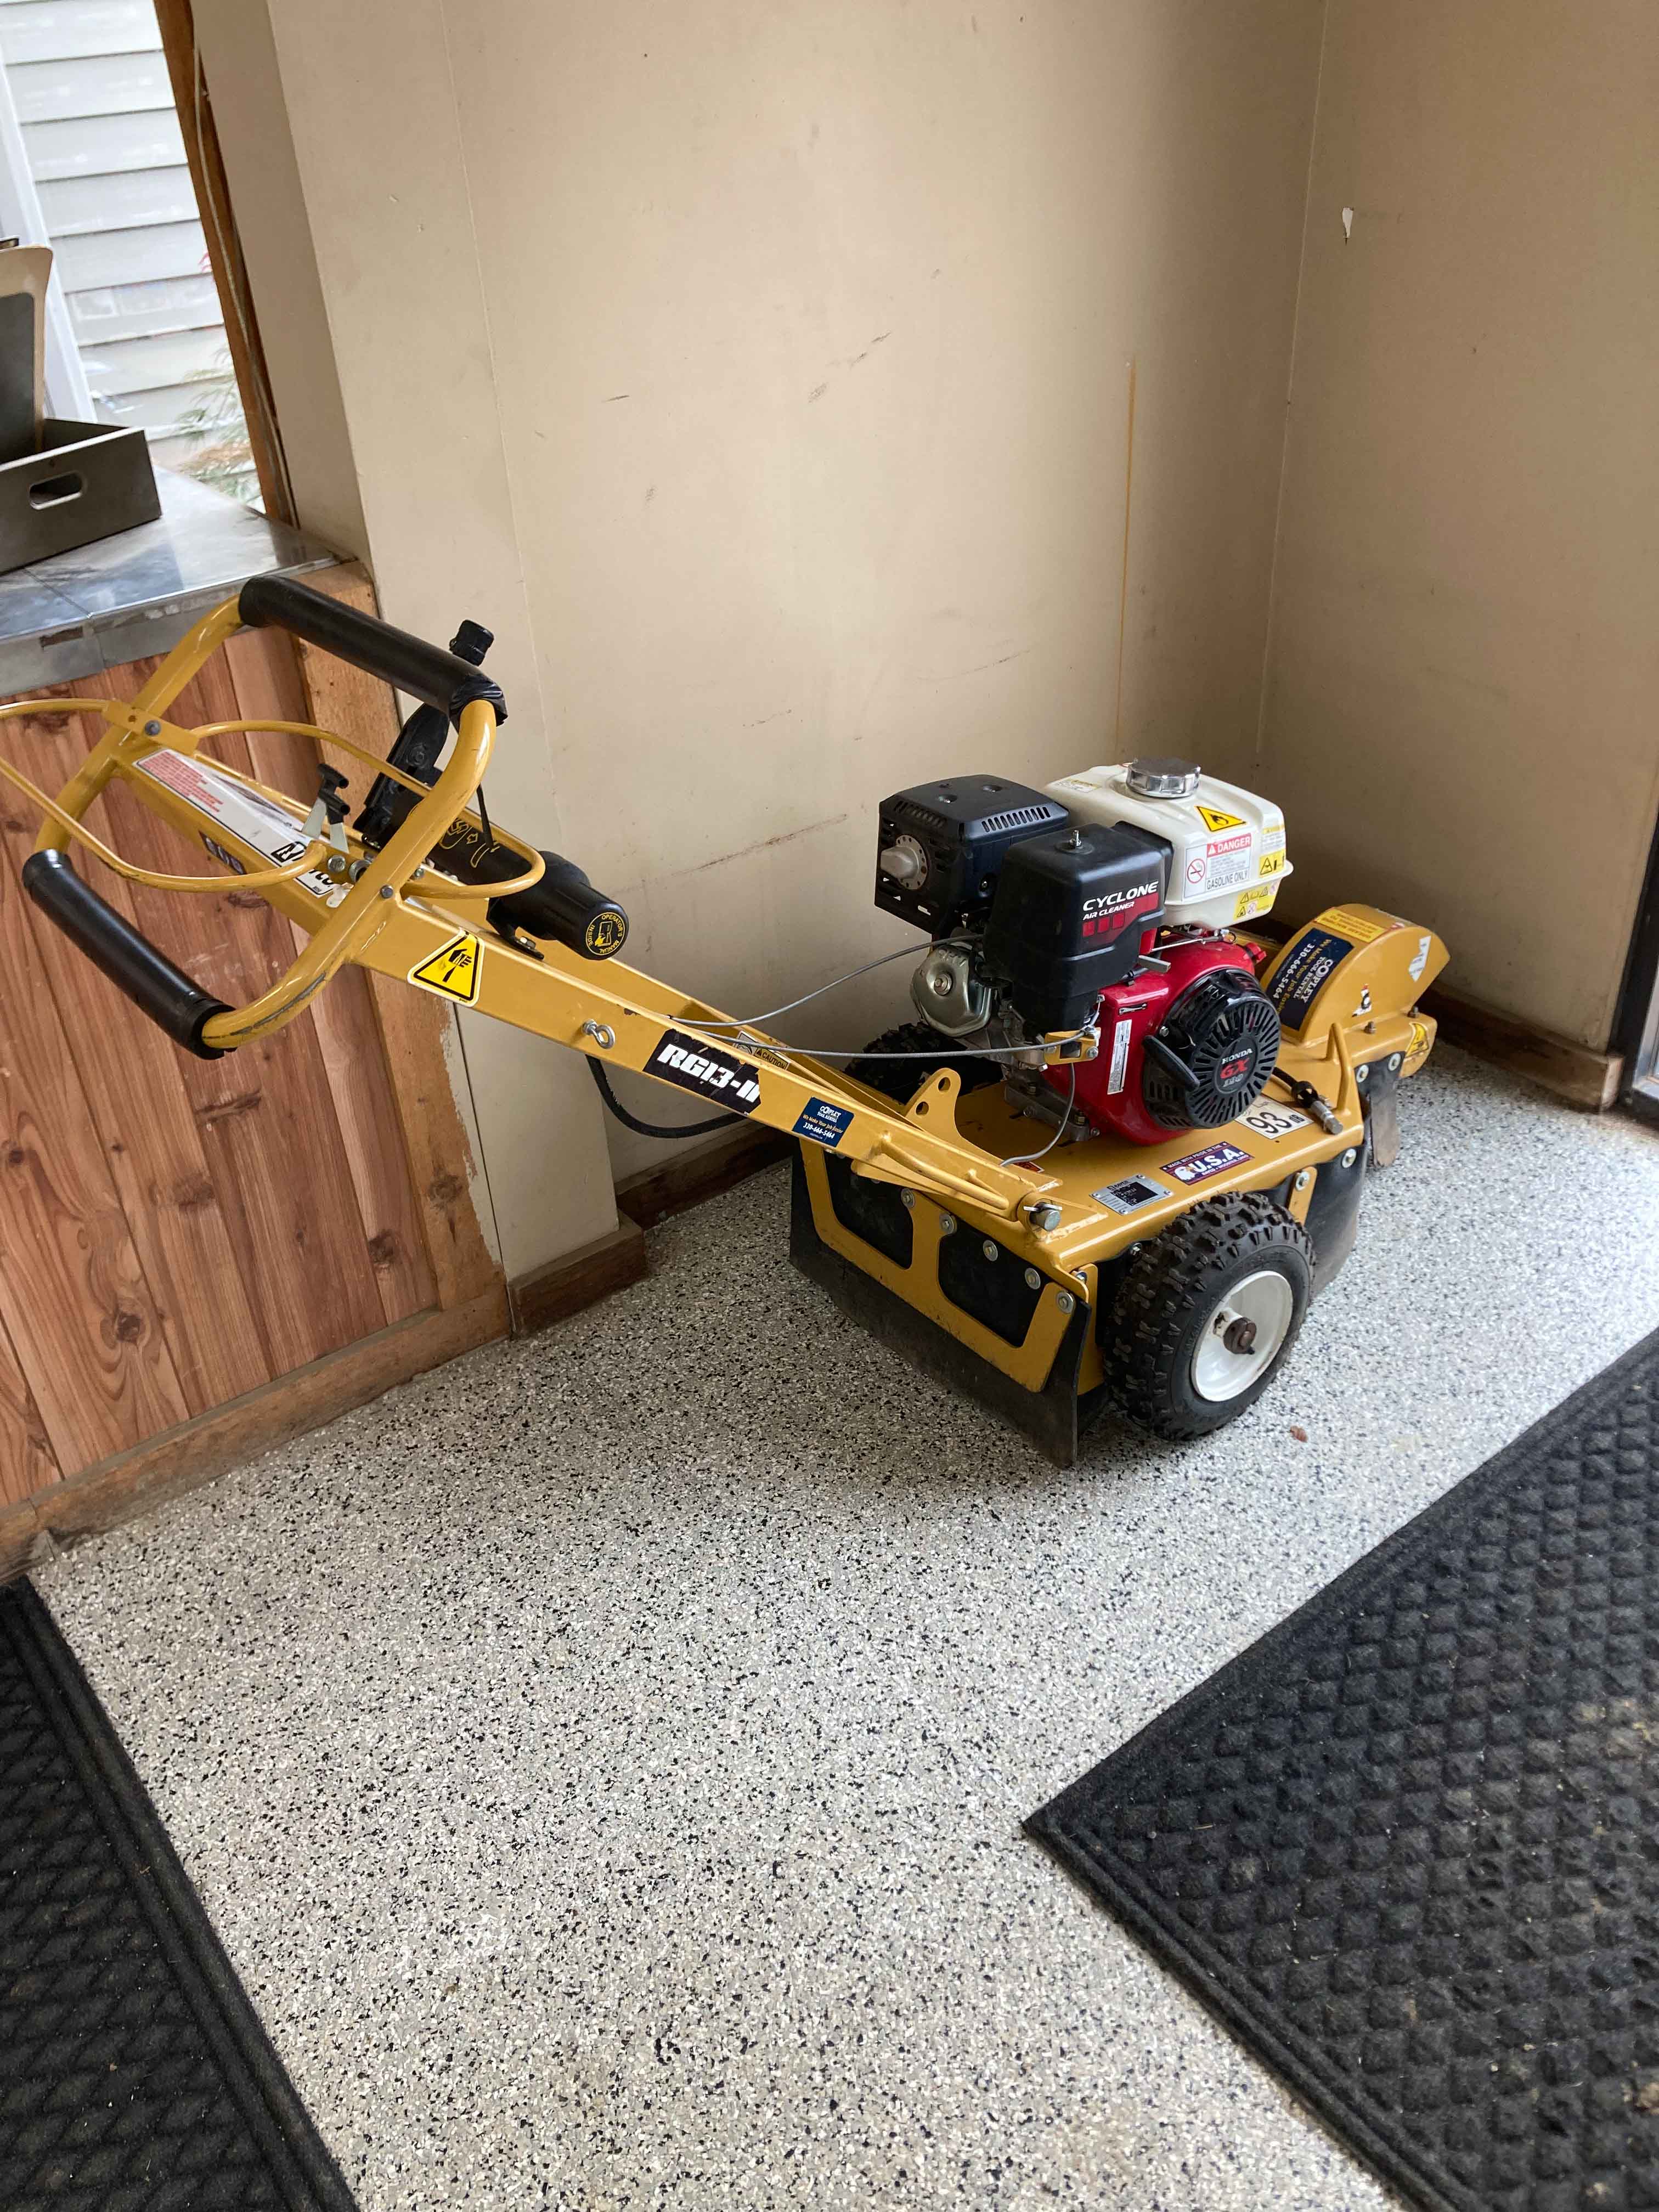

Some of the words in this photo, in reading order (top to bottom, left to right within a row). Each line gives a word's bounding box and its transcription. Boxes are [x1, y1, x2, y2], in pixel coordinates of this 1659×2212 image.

[1217, 836, 1251, 853] DANGER
[1207, 872, 1234, 890] GASOLINE
[1234, 870, 1248, 881] ONLY
[1083, 881, 1159, 911] CYCLONE
[1082, 911, 1098, 921] AIR
[1099, 901, 1135, 916] CLEANER
[601, 914, 623, 937] OPERATOR'S
[587, 924, 596, 947] INSIDE
[599, 939, 619, 953] MANUAL
[1306, 949, 1323, 964] Make
[1310, 956, 1325, 972] TOOL
[1273, 943, 1316, 999] 330-666-5464
[1295, 964, 1309, 979] Your
[1287, 980, 1297, 992] Job
[1293, 972, 1313, 998] RENTAL
[1301, 959, 1334, 1003] COPLEY
[762, 1052, 787, 1069] CAUTION
[1221, 1048, 1253, 1064] HONDA
[1220, 1057, 1250, 1080] GX
[820, 1105, 842, 1118] COPLEY
[803, 1122, 836, 1139] 330-666-5464
[1246, 1112, 1292, 1133] 93
[1167, 1159, 1181, 1168] MADE
[1181, 1155, 1194, 1164] WITH
[1193, 1150, 1207, 1158] PRIDE
[1188, 1148, 1245, 1172] U.S.A.
